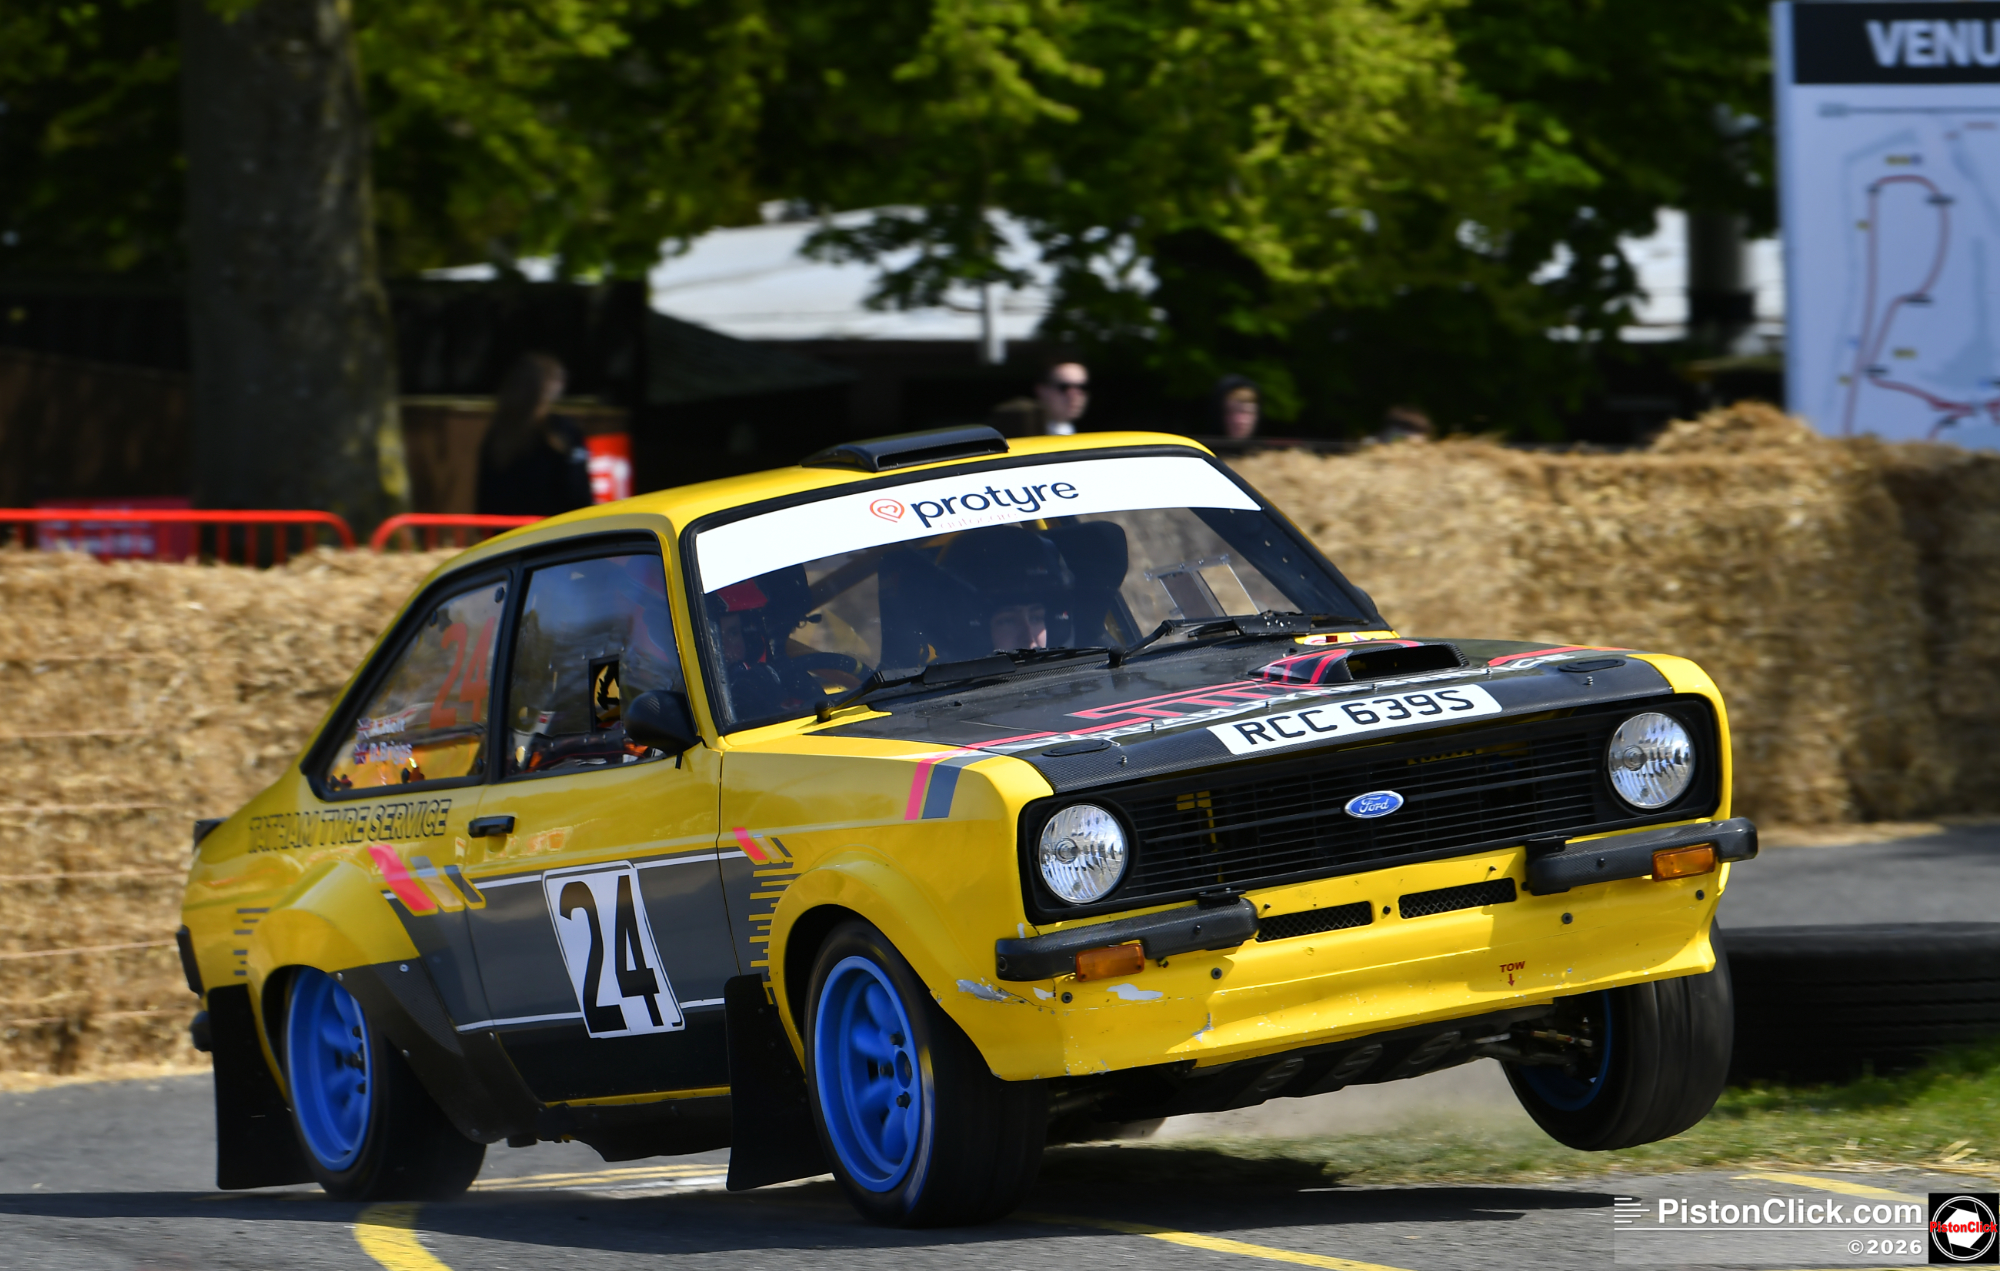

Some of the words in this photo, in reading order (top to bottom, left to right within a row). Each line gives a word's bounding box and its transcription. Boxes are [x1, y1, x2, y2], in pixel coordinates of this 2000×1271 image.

[911, 481, 1079, 529] protyre
[430, 616, 496, 729] 24
[1234, 706, 1337, 745] RCC
[1340, 689, 1475, 725] 639S
[320, 806, 371, 846] TYRE
[368, 798, 452, 842] SERVICE
[1358, 796, 1391, 814] Ford
[560, 874, 663, 1033] 24
[1499, 960, 1526, 973] TOW
